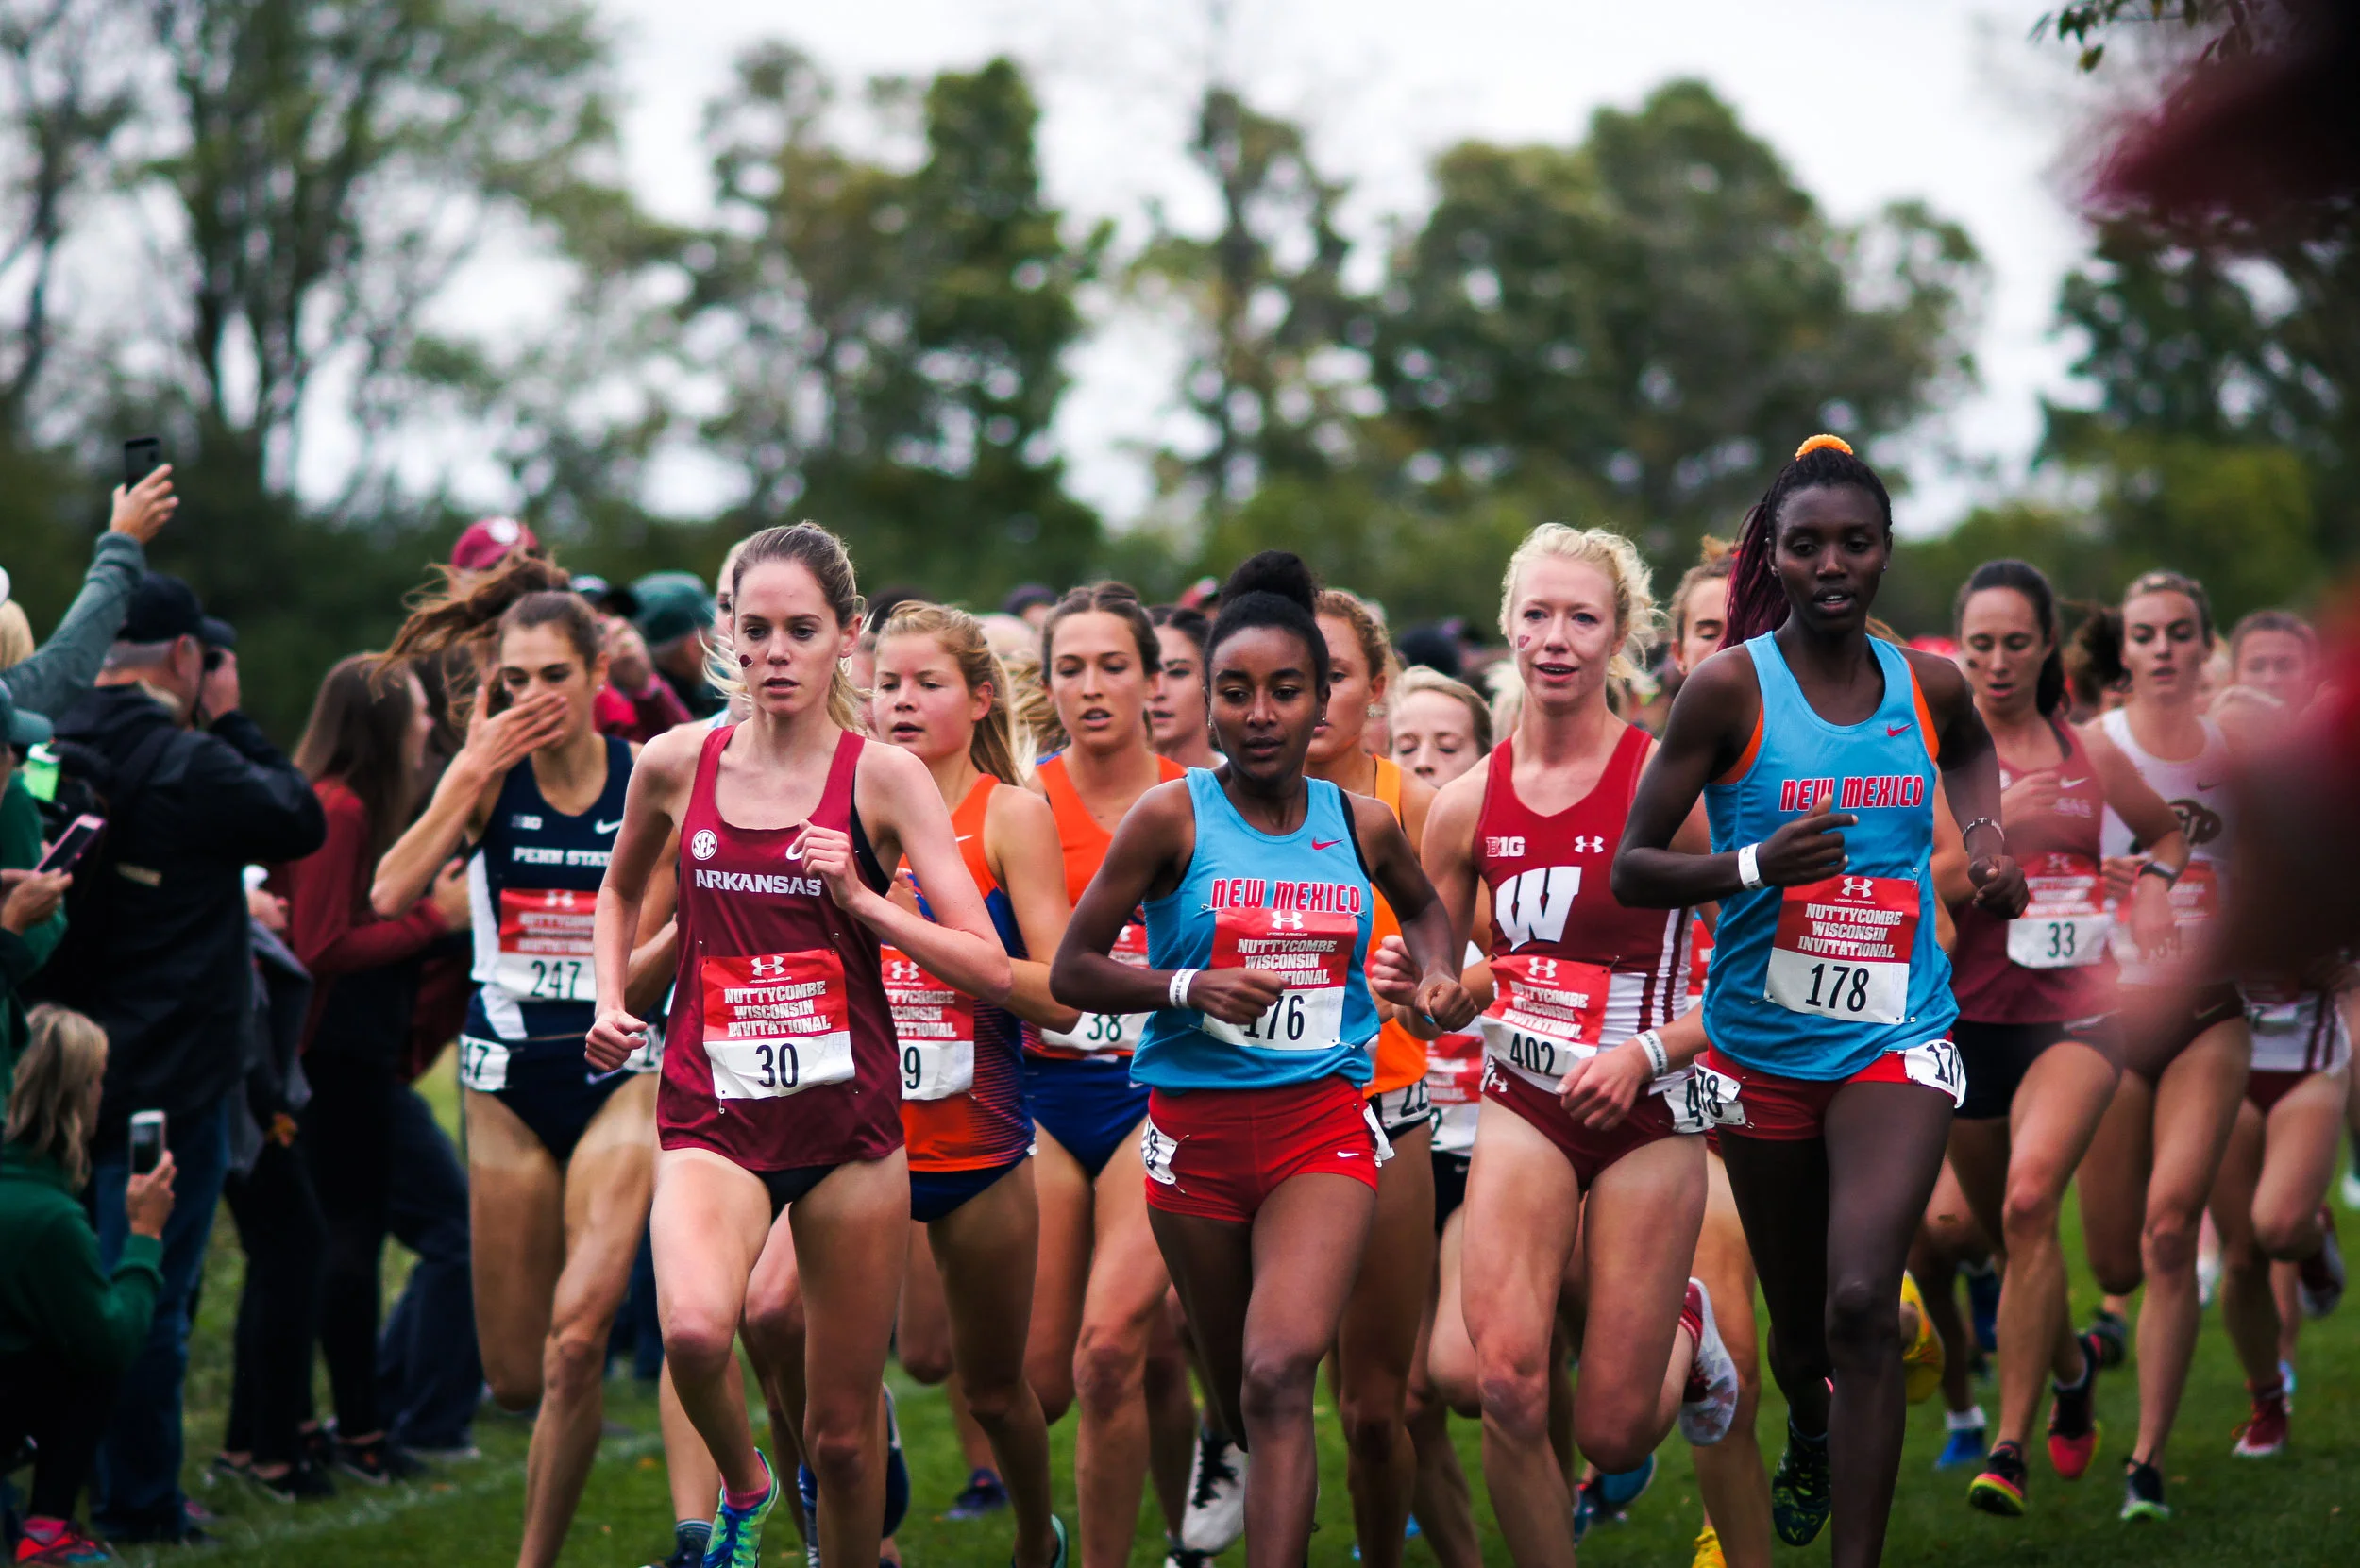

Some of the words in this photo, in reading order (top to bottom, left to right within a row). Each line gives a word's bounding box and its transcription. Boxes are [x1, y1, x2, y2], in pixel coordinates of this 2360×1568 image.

[1779, 777, 1834, 812] NEW
[1841, 775, 1924, 809] MEXICO
[513, 847, 564, 865] PENN
[566, 851, 612, 866] STAT
[694, 835, 716, 856] SEC
[695, 868, 821, 896] ARKANSAS
[1211, 878, 1266, 908] NEW
[1273, 881, 1361, 913] MEXICO
[1496, 866, 1583, 952] W
[1805, 903, 1903, 926] NUTTYCOMBE
[1812, 921, 1888, 942] WISCONSIN
[2048, 922, 2076, 958] 33
[1238, 939, 1337, 953] NUTTYCOMBE
[1797, 935, 1895, 959] INVITATIONAL
[1245, 953, 1320, 969] WISCONSIN
[531, 960, 582, 998] 247
[1805, 962, 1870, 1013] 178
[724, 981, 826, 1004] NUTTYCOMBE
[734, 1000, 815, 1019] WISCONSIN
[728, 1015, 832, 1038] INVITATIONAL
[755, 1043, 799, 1088] 30
[1510, 1033, 1555, 1076] 402
[1696, 1068, 1724, 1119] 78
